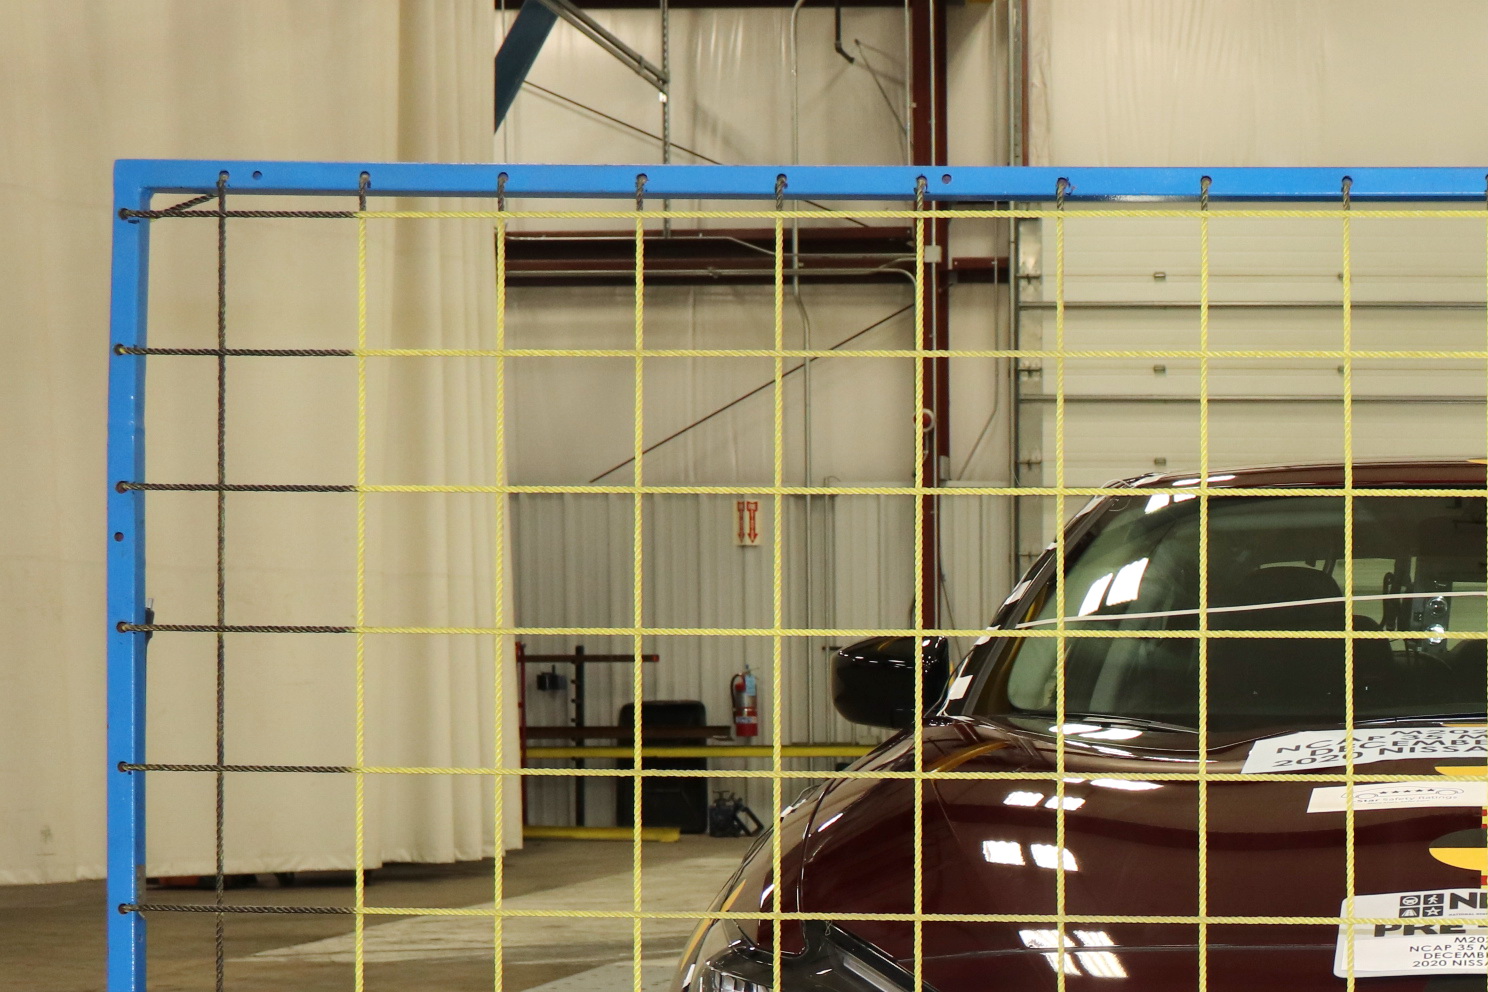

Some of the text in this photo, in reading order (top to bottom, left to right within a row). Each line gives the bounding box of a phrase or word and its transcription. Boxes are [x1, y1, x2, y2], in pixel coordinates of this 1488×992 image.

[1276, 735, 1385, 754] NCAP
[1272, 752, 1363, 767] 2020
[1409, 944, 1452, 952] NCAP
[1412, 959, 1447, 968] 2020
